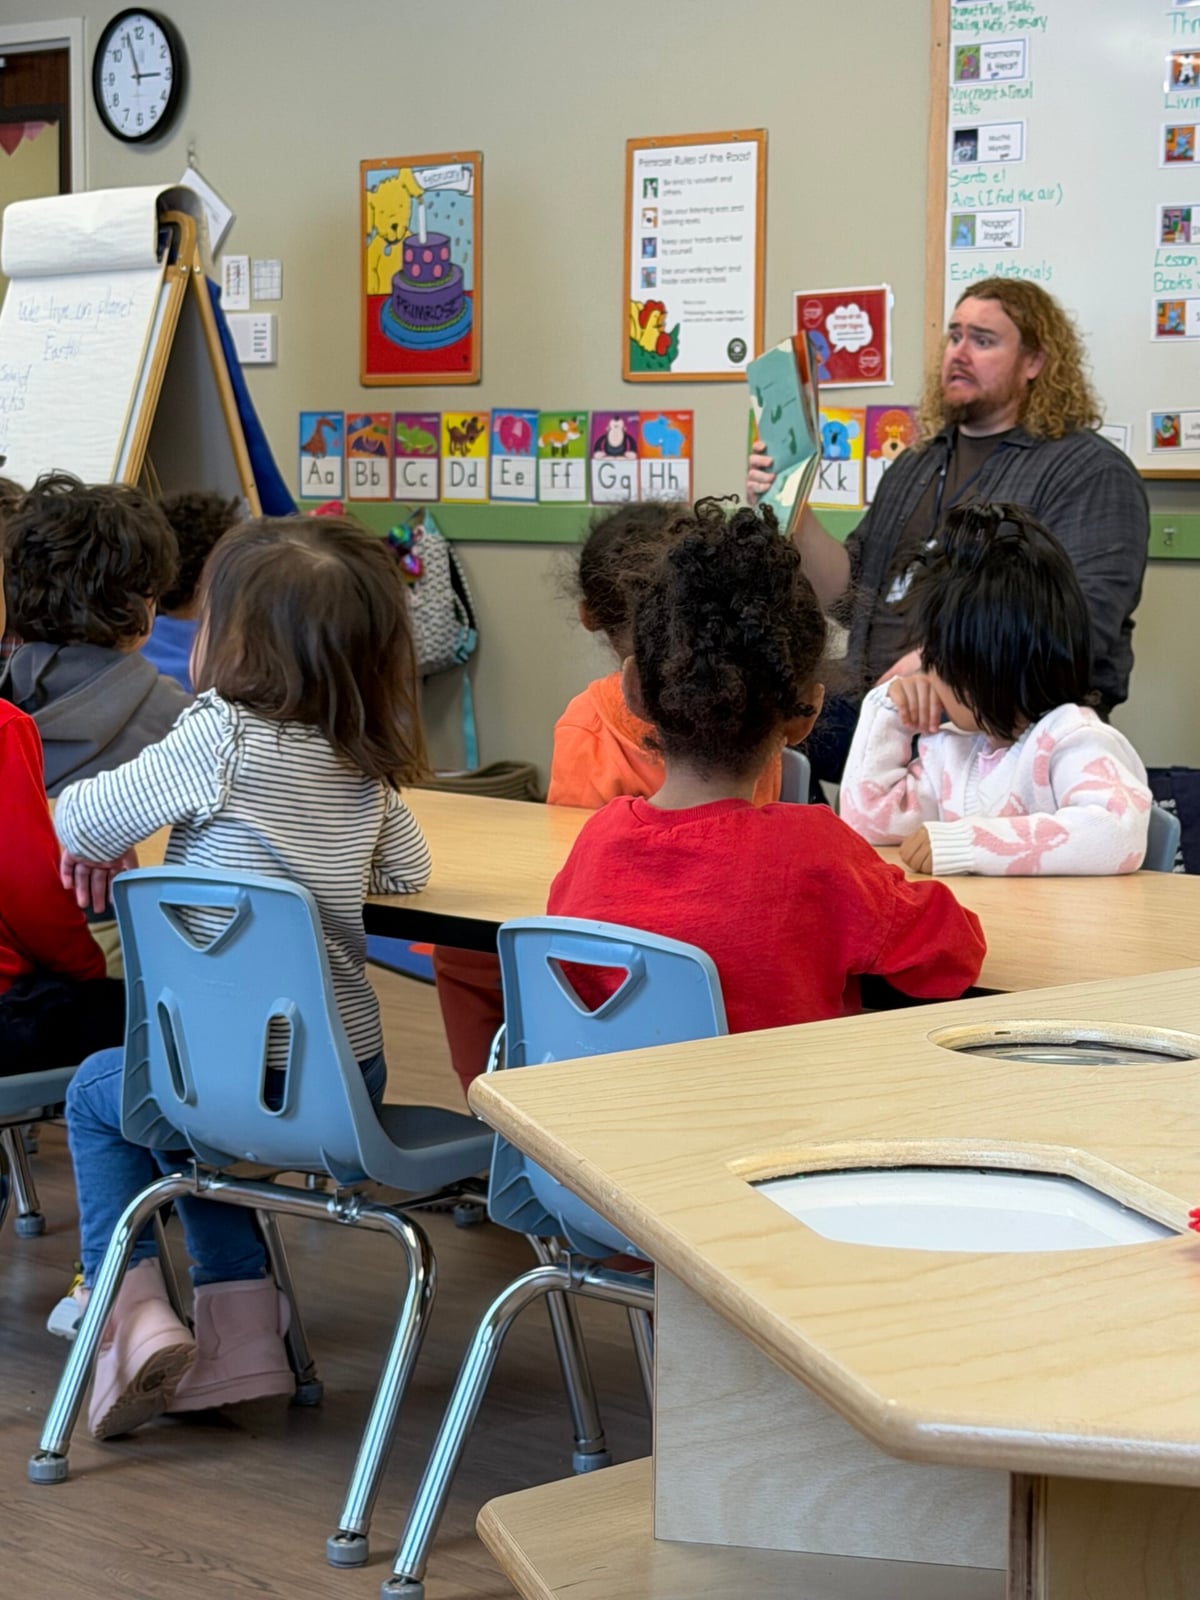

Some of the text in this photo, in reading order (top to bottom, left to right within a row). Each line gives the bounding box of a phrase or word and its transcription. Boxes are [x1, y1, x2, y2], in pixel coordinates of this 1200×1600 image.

[134, 26, 144, 40] 12
[149, 32, 155, 45] 1
[112, 50, 122, 63] 10
[160, 45, 167, 59] 2
[108, 72, 116, 86] 9
[164, 67, 172, 81] 3
[113, 93, 120, 107] 8
[160, 89, 167, 101] 4
[122, 108, 130, 122] 7
[149, 105, 157, 119] 5
[136, 113, 144, 126] 6
[674, 155, 697, 165] Rules
[698, 153, 708, 164] of
[709, 153, 724, 163] the
[725, 151, 751, 162] Road
[1154, 248, 1197, 267] Lesson
[950, 262, 989, 281] Earth
[306, 460, 335, 485] Aa
[355, 461, 381, 487] Bb
[403, 461, 428, 487] Cc
[450, 461, 478, 487] Dd
[501, 459, 525, 486] Ee
[551, 462, 573, 489] Ff
[649, 463, 680, 490] Hh
[818, 461, 848, 491] Kk
[598, 463, 632, 501] Gg
